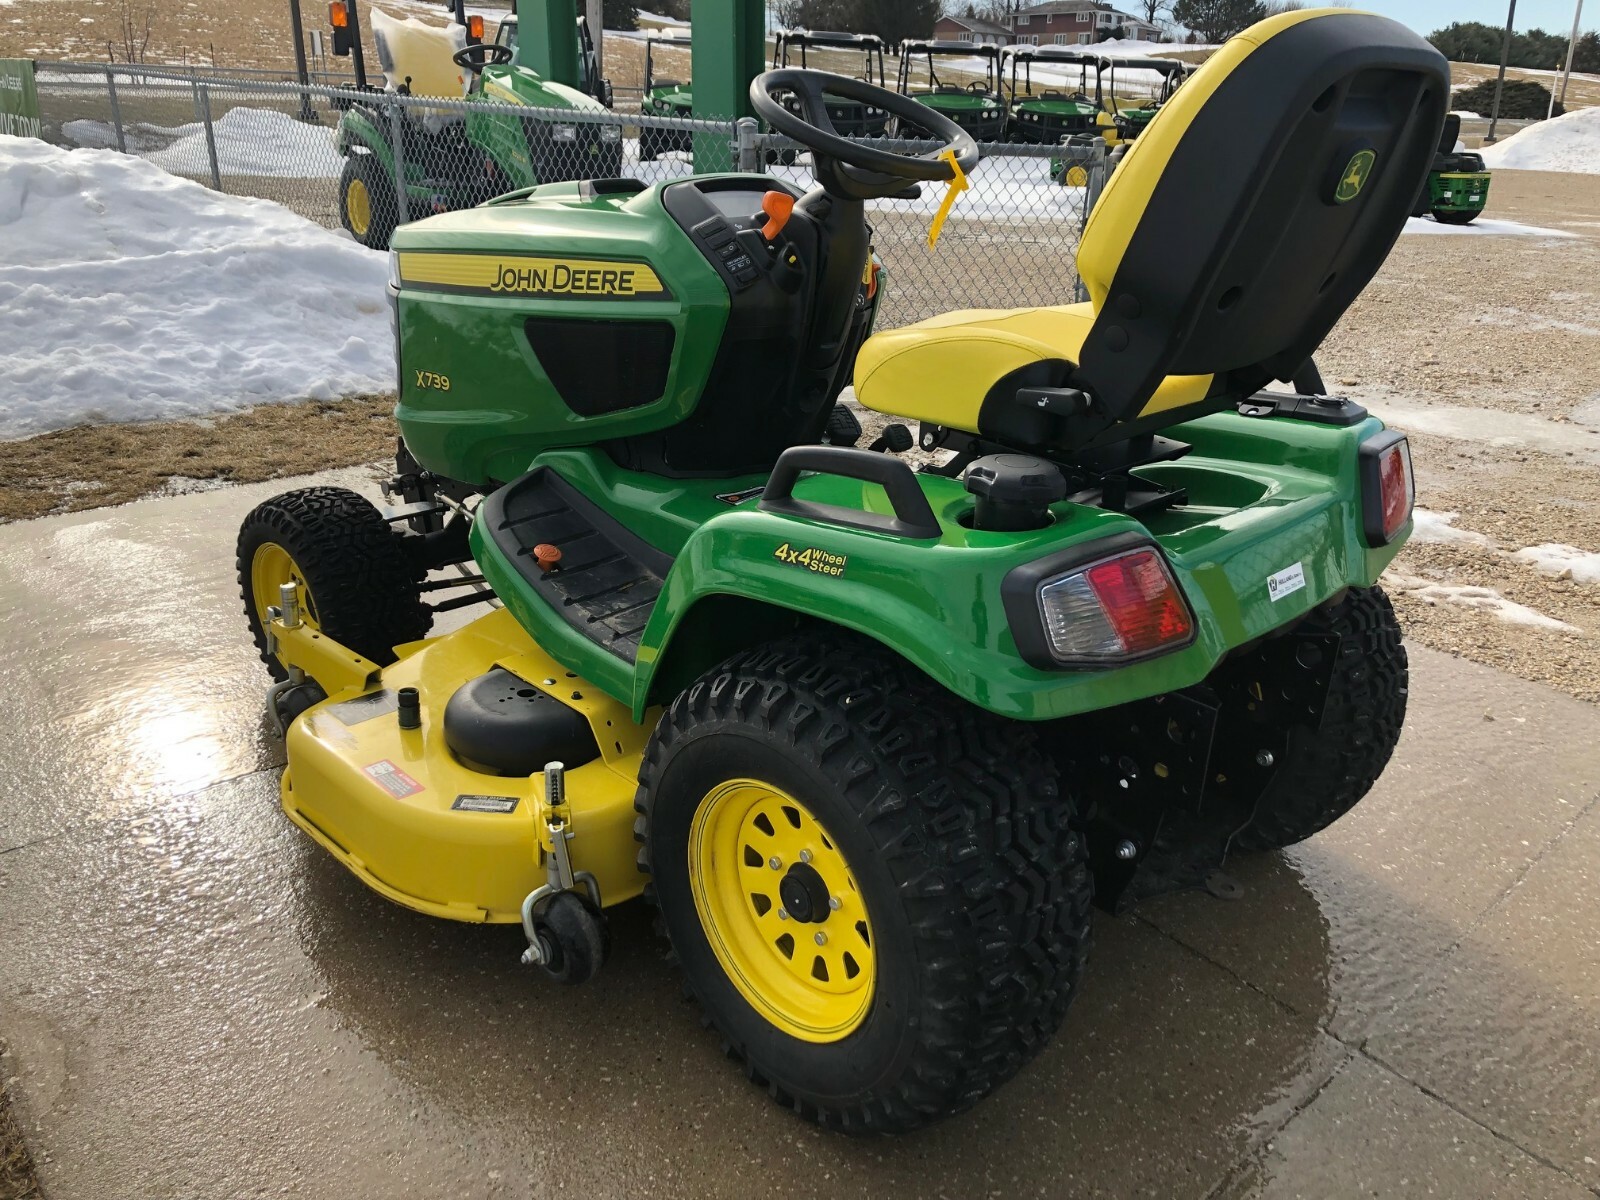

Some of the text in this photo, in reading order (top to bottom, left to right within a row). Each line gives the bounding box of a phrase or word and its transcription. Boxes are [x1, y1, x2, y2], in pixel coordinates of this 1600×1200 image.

[490, 264, 635, 292] JOHN DEERE
[415, 369, 450, 391] X739
[774, 542, 847, 566] 4x4 Wheel
[809, 559, 844, 576] Steer
